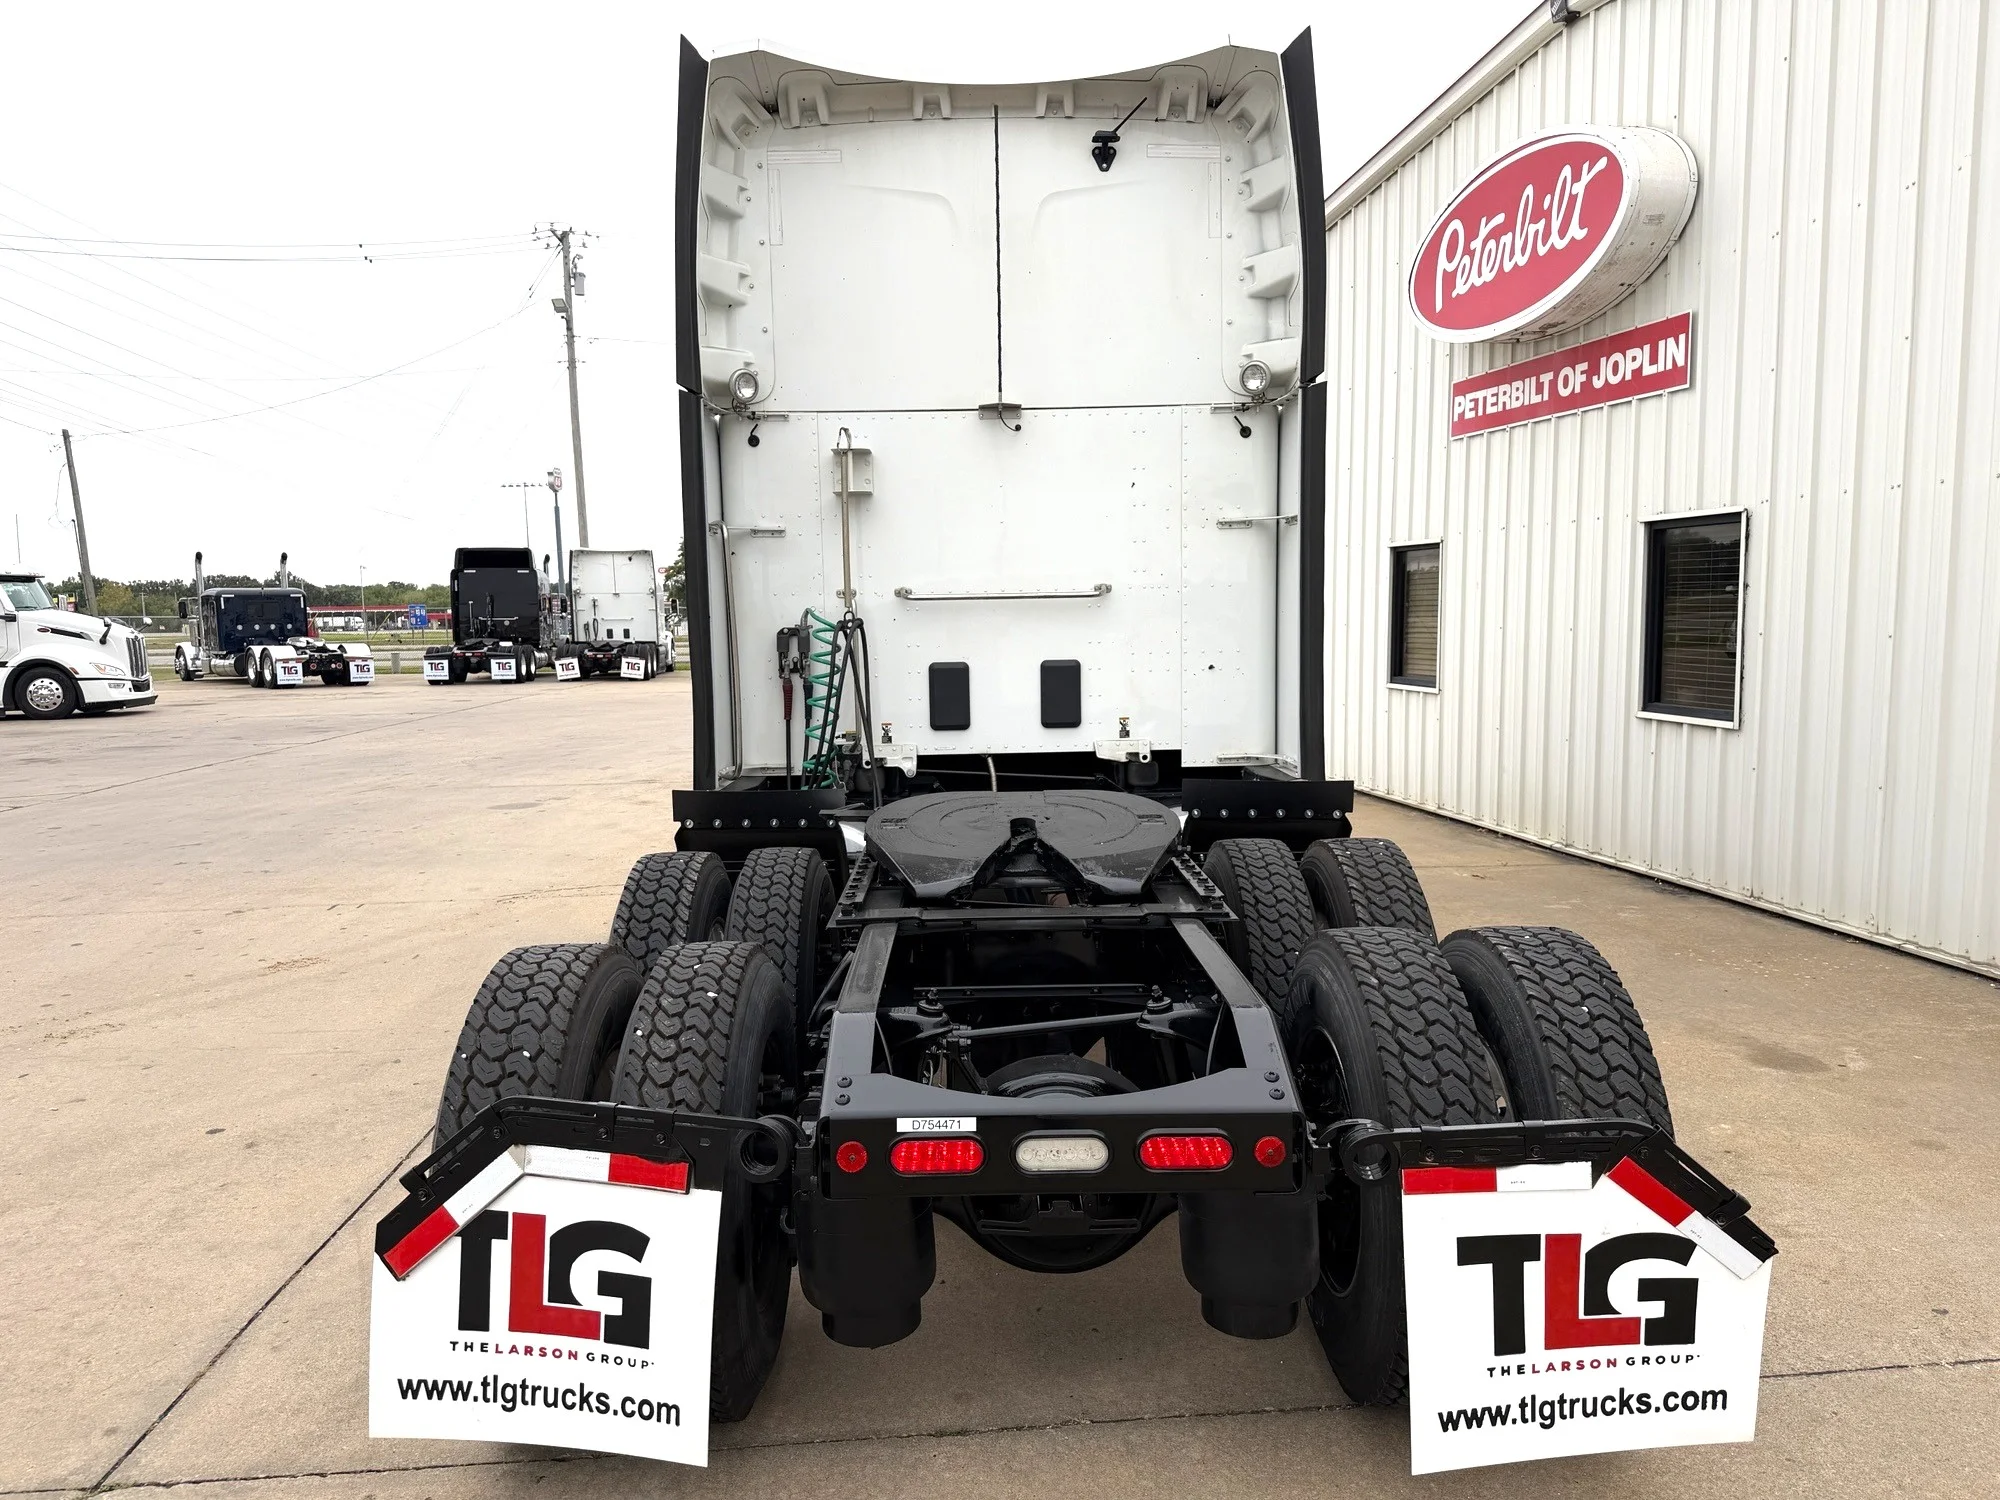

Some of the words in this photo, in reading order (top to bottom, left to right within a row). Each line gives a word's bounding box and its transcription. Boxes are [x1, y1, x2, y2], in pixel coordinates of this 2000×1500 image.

[1435, 156, 1608, 314] Peterbilt
[1453, 371, 1553, 422] PETERBILT
[1557, 361, 1589, 398] OF
[1592, 333, 1687, 389] JOPLIN
[281, 666, 298, 675] TLG
[354, 664, 370, 673] TLG
[428, 662, 445, 671] TLG
[496, 662, 512, 670] TLG
[559, 662, 575, 672] TLG
[625, 662, 641, 671] TLG
[912, 1120, 961, 1130] D754471
[456, 1210, 653, 1349] TLG
[1457, 1232, 1699, 1356] TLG
[494, 1343, 579, 1361] LARSON
[586, 1352, 651, 1369] GROUP
[1532, 1357, 1617, 1374] LARSON
[1626, 1354, 1695, 1367] GROUP
[397, 1374, 681, 1427] www.tlgtrucks.com
[1438, 1387, 1728, 1433] www.tlgtrucks.com
